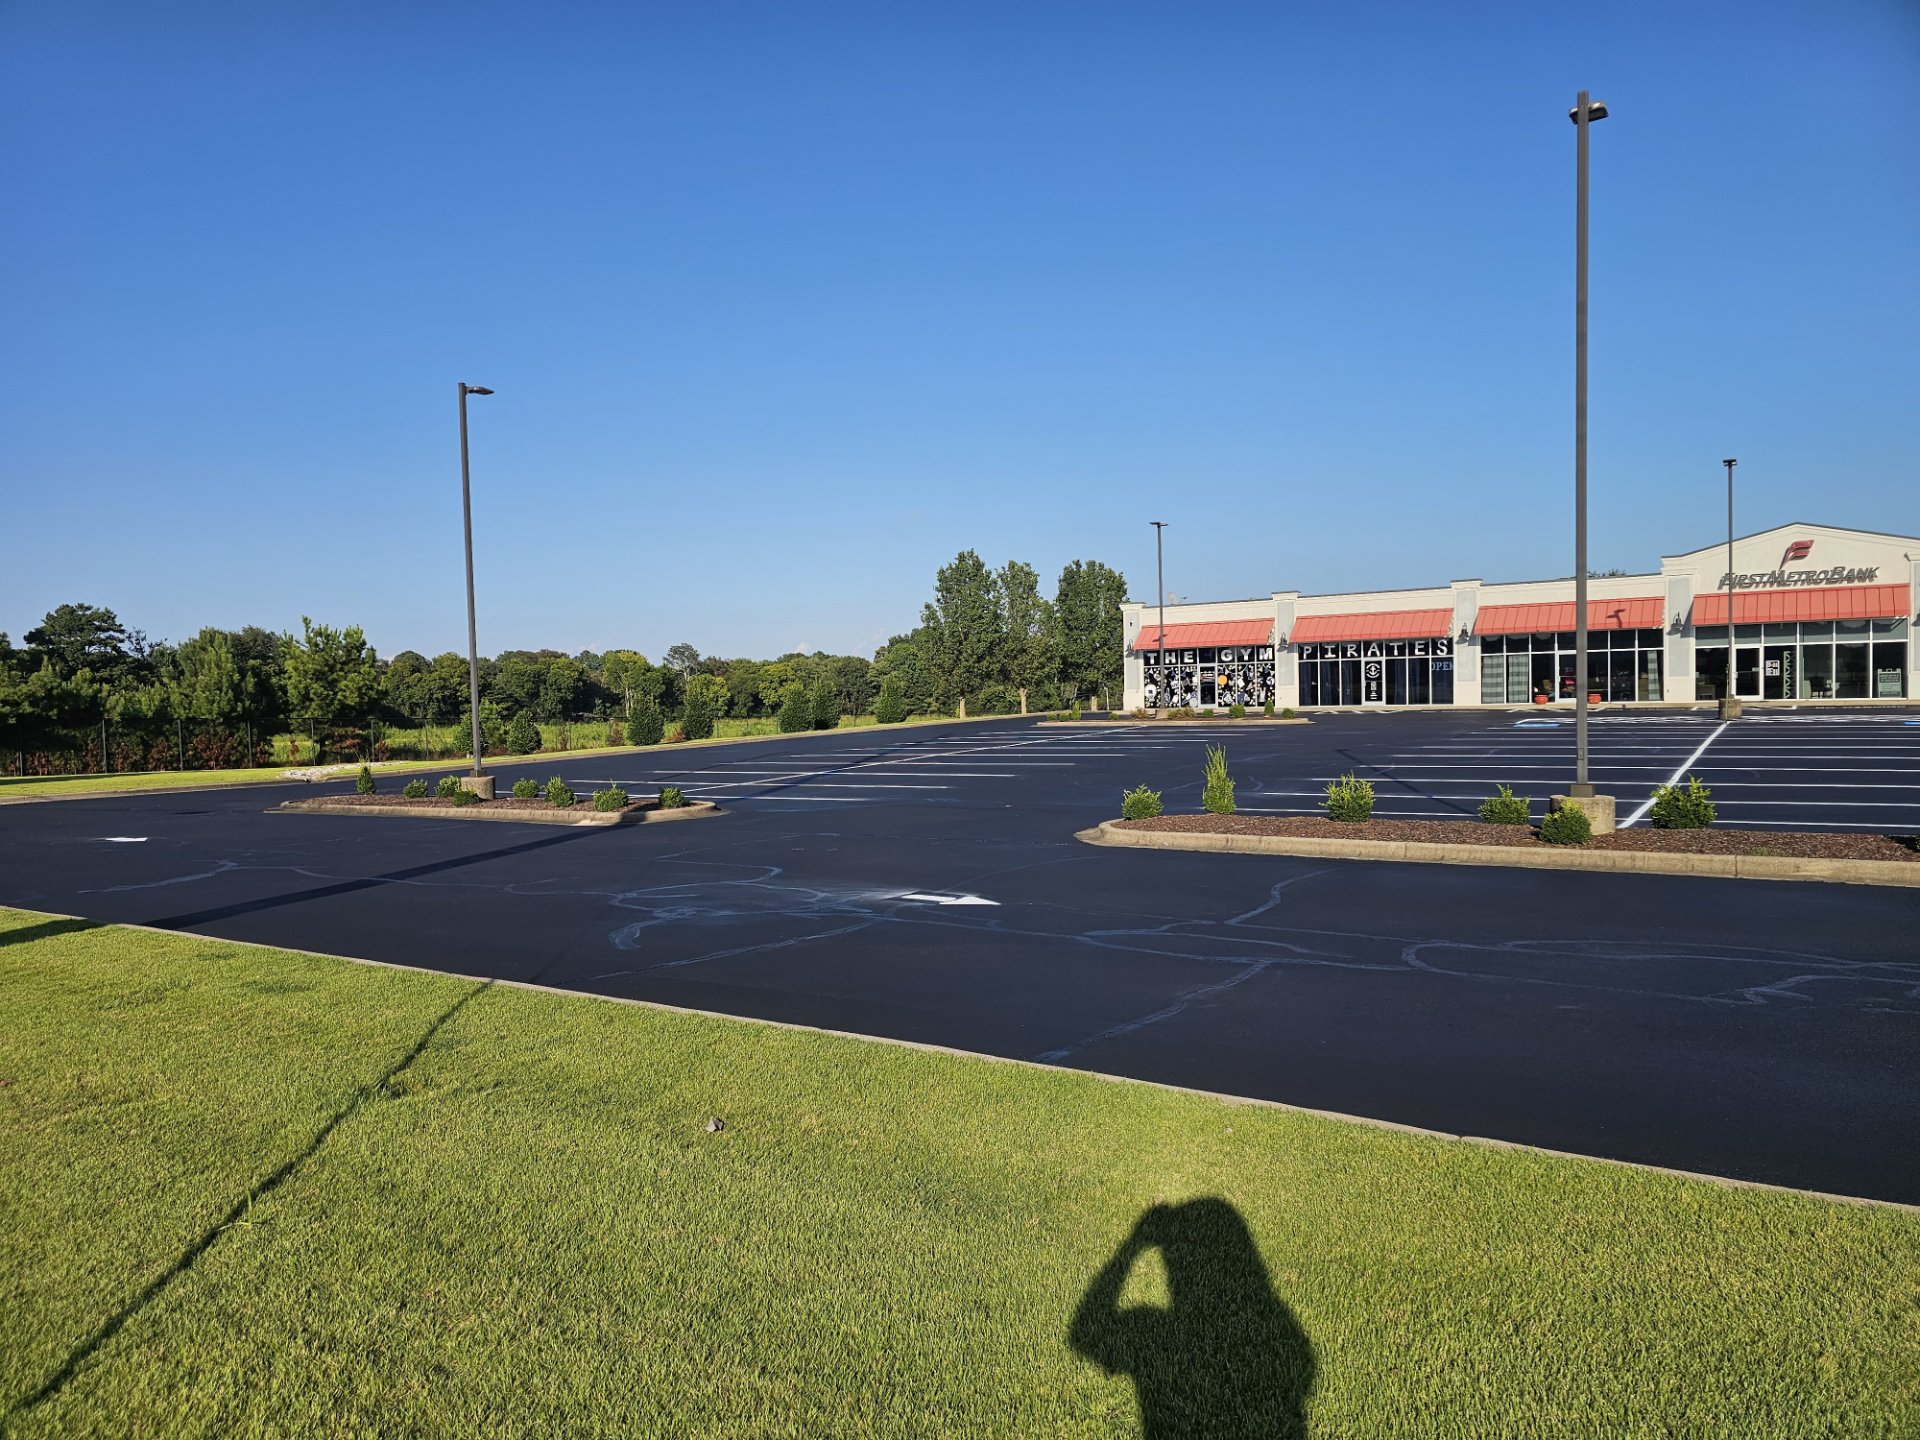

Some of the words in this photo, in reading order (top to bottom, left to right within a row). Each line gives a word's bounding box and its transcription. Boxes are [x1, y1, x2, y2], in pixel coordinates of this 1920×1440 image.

[1147, 651, 1194, 665] THE
[1220, 647, 1273, 662] GYM
[1303, 639, 1449, 659] PIRATES
